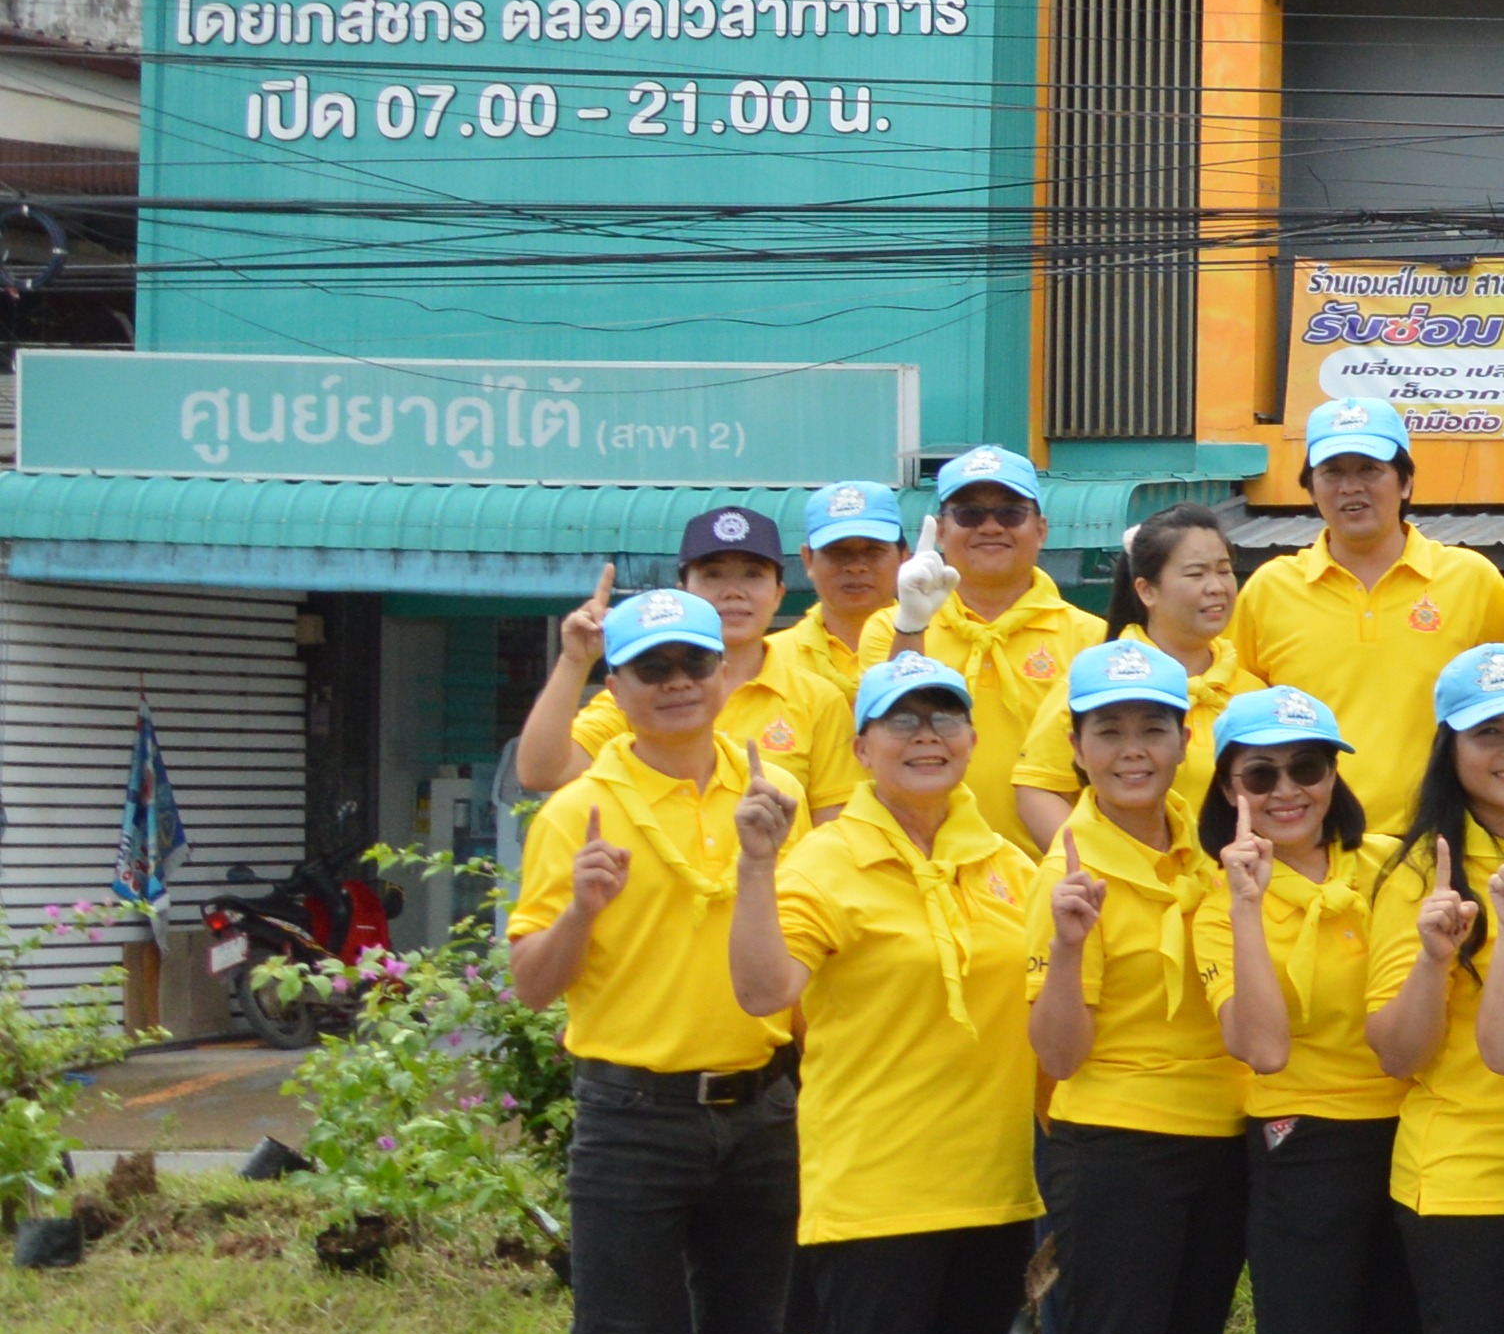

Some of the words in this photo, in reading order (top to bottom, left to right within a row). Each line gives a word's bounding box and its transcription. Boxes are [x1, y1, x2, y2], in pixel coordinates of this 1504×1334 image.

[246, 72, 357, 142] เปิด
[376, 82, 560, 141] 07.00
[577, 106, 611, 120] -
[627, 77, 813, 136] 21.00
[829, 83, 892, 134] น.
[1341, 357, 1458, 378] เปลี่ยนจอ
[180, 373, 582, 468] ศูนย์ยาดู่ใต้
[597, 420, 699, 457] (สาขา
[709, 420, 746, 458] 2)
